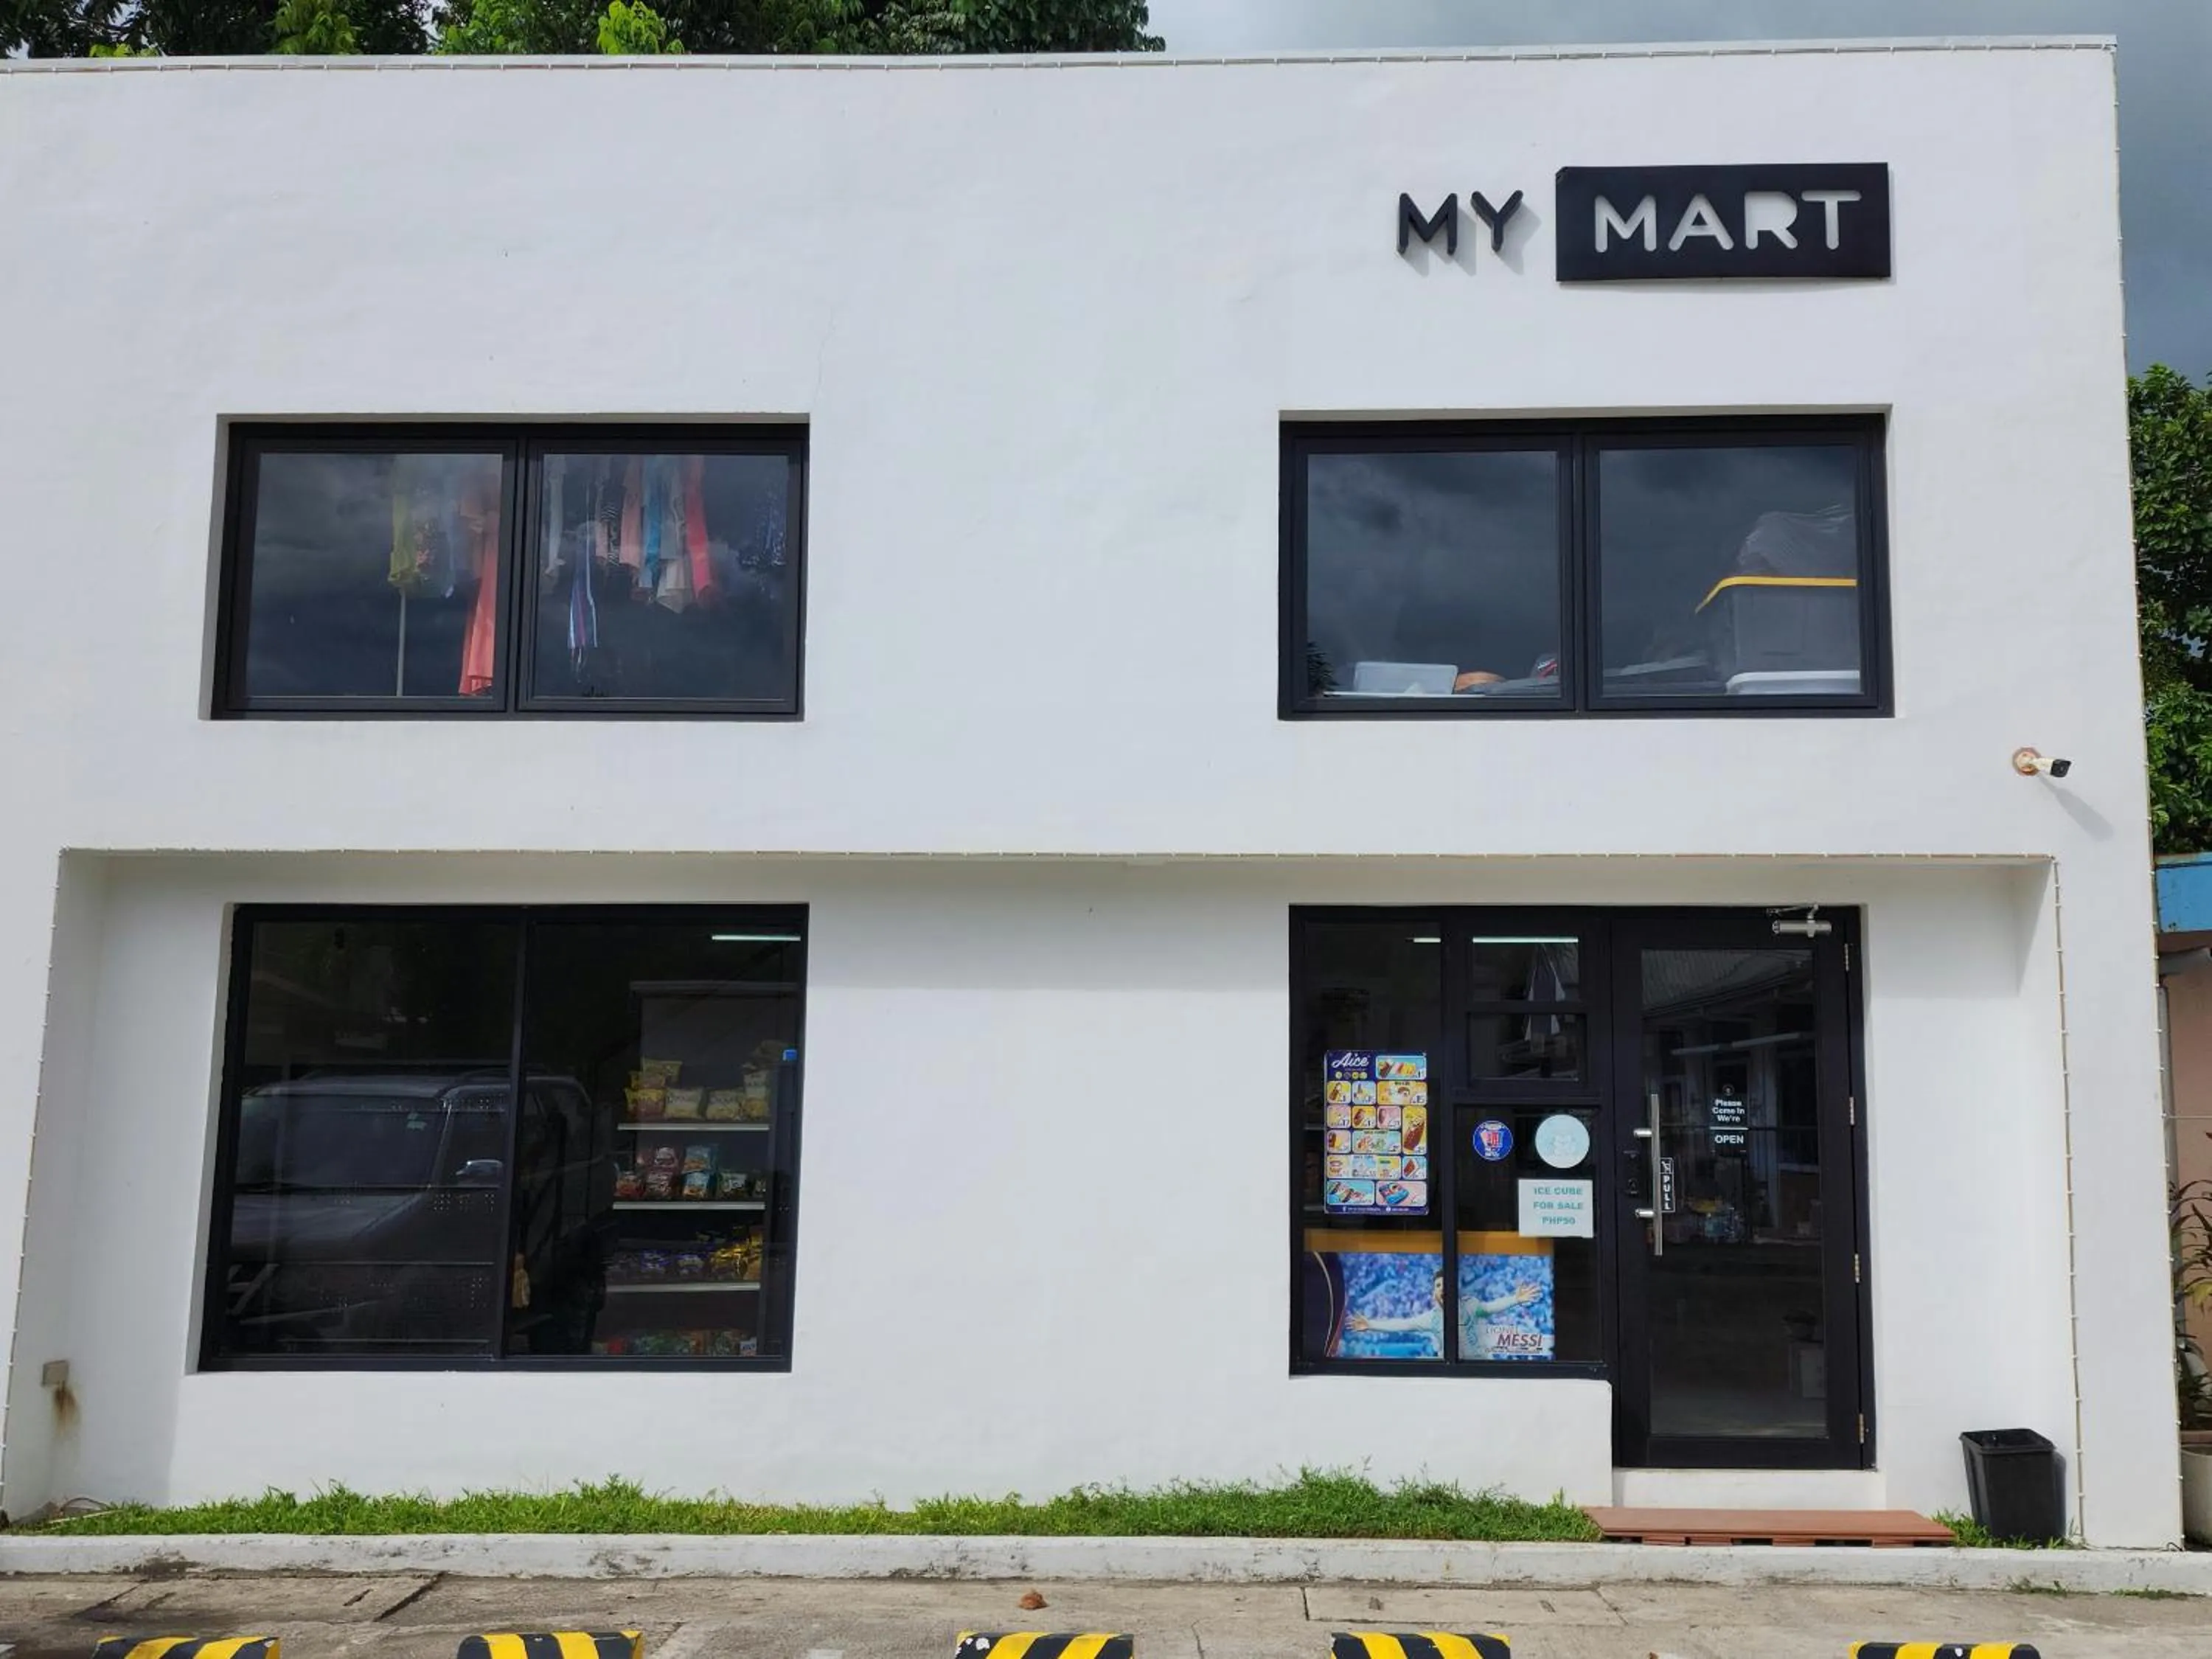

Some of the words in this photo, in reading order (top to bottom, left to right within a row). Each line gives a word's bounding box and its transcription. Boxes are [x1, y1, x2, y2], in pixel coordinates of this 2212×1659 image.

[1397, 189, 1523, 255] MY
[1594, 189, 1862, 254] MART
[1331, 1052, 1369, 1068] Aice
[1717, 1114, 1741, 1122] We're
[1714, 1135, 1745, 1144] OPEN
[1534, 1187, 1551, 1195] ICE
[1554, 1187, 1583, 1195] CUBE
[1663, 1175, 1672, 1210] PULL
[1533, 1201, 1554, 1210] FOR
[1557, 1201, 1584, 1210] SALE
[1542, 1216, 1576, 1225] PHP50
[1498, 1333, 1543, 1347] MESSI
